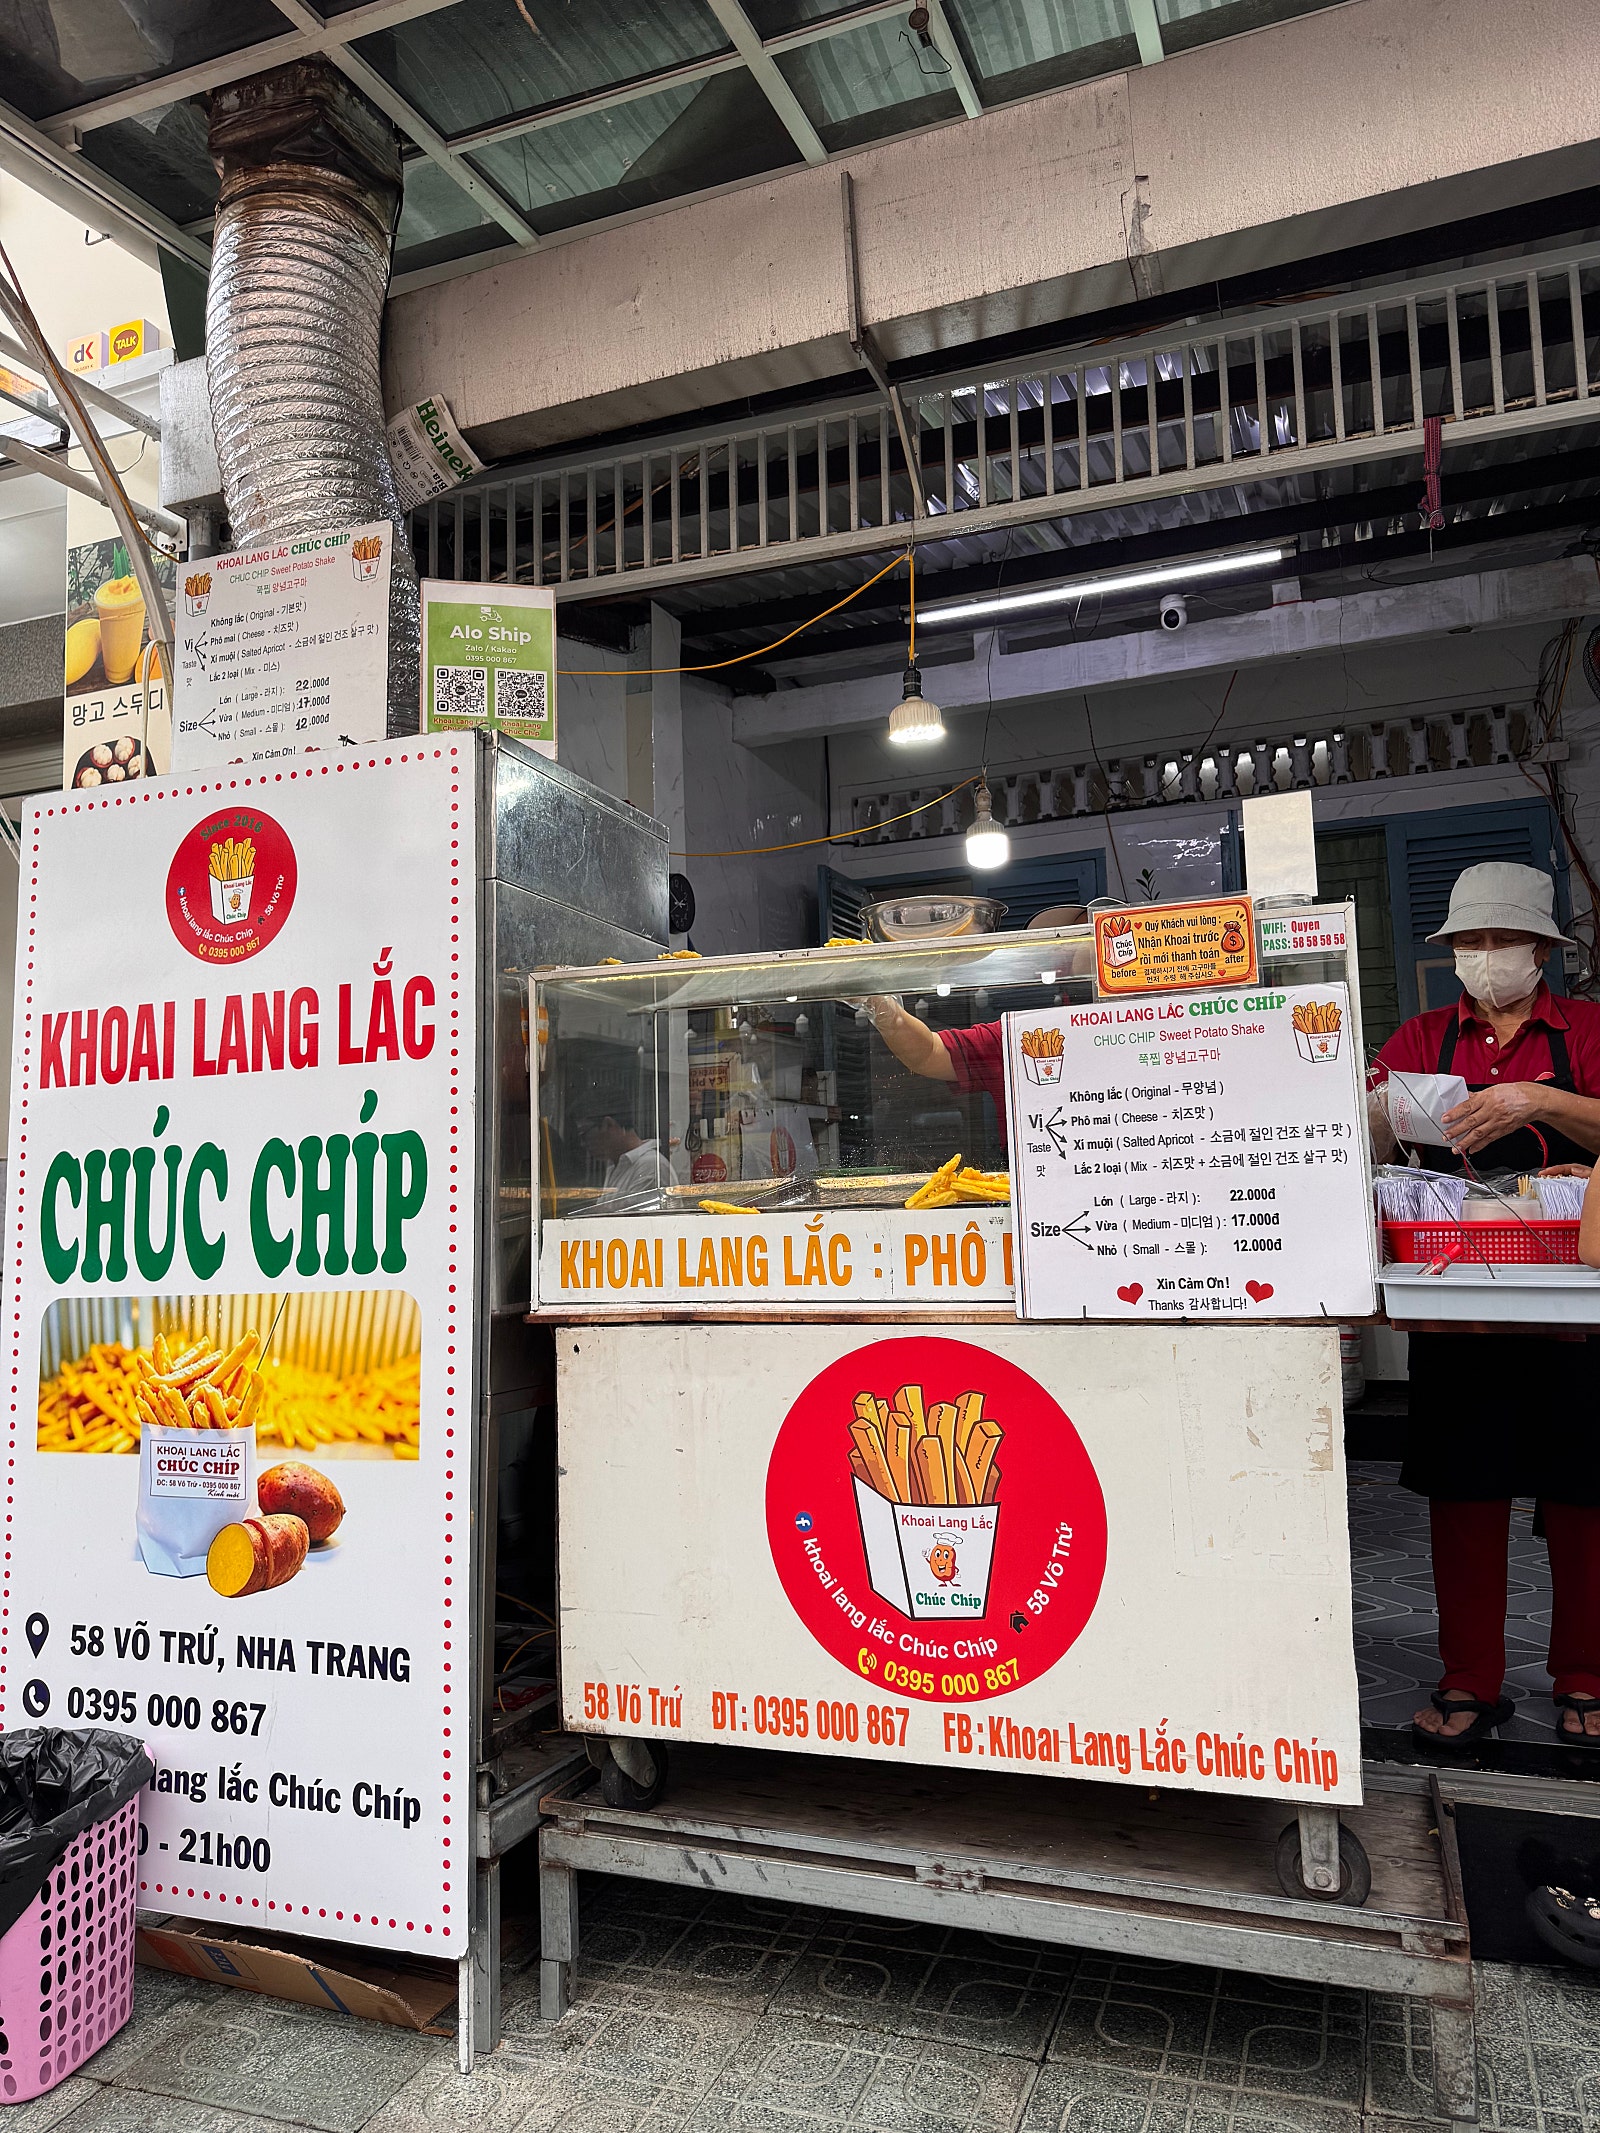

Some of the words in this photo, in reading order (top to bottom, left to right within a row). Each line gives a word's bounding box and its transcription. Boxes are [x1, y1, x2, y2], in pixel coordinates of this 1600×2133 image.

[116, 336, 136, 349] TALK
[217, 556, 243, 570] KHOAI
[246, 551, 269, 564] LANG
[291, 538, 321, 555] CHÚC
[324, 531, 350, 546] CHÍP
[230, 572, 250, 583] CHUC
[252, 568, 269, 580] CHIP
[271, 565, 291, 576] Sweet
[293, 560, 313, 572] Potato
[315, 556, 335, 566] Shake
[450, 625, 482, 640] Alo
[488, 626, 531, 645] Ship
[492, 645, 517, 654] Kakao
[503, 656, 517, 664] 867
[72, 700, 104, 726] 망고
[200, 819, 230, 840] Since
[234, 814, 263, 833] 2016
[1145, 921, 1159, 932] Quý
[1161, 918, 1184, 930] Khách
[1186, 916, 1198, 927] vui
[1263, 922, 1286, 934] WIFI:
[1291, 921, 1319, 933] Quyen
[1138, 936, 1162, 950] Nhận
[1164, 934, 1190, 947] Khoai
[1193, 931, 1219, 943] trước
[1264, 938, 1290, 951] PASS:
[1293, 937, 1304, 948] 58
[1307, 936, 1317, 947] 58
[1320, 934, 1331, 946] 58
[1334, 933, 1345, 945] 58
[1140, 953, 1151, 965] rồi
[1153, 954, 1169, 964] mới
[1171, 950, 1197, 962] thanh
[1200, 949, 1220, 959] toán
[1225, 954, 1244, 964] after
[1111, 968, 1137, 979] before
[39, 1001, 175, 1089] KHOAI
[192, 986, 320, 1077] LANG
[338, 947, 435, 1064] LẮC
[1071, 1010, 1112, 1027] KHOAI
[1117, 1007, 1154, 1023] LANG
[1189, 996, 1238, 1016] CHÚC
[1243, 992, 1286, 1011] CHÍP
[1094, 1033, 1125, 1046] CHUC
[1129, 1032, 1155, 1044] CHIP
[1159, 1029, 1191, 1041] Sweet
[1194, 1027, 1228, 1039] Potato
[1232, 1022, 1265, 1035] Shake
[1070, 1090, 1104, 1103] Không
[1108, 1086, 1122, 1099] lắc
[1132, 1085, 1171, 1099] Original
[1182, 1080, 1216, 1094] 무양념
[1029, 1114, 1043, 1132] Vị
[1071, 1115, 1090, 1126] Phô
[1093, 1114, 1110, 1124] mai
[1122, 1112, 1158, 1123] Cheese
[1172, 1106, 1205, 1120] 치즈맛
[1088, 1138, 1113, 1151] muội
[1123, 1136, 1155, 1148] Salted
[1158, 1134, 1194, 1147] Apricot
[1210, 1128, 1246, 1143] 소금에
[1249, 1127, 1273, 1141] 절인
[1276, 1126, 1301, 1139] 건조
[1304, 1124, 1328, 1138] 살구
[1027, 1142, 1051, 1153] Taste
[1037, 1165, 1046, 1177] 맛
[1075, 1162, 1092, 1174] Lắc
[1094, 1164, 1100, 1173] 2
[1104, 1162, 1121, 1175] loại
[1131, 1161, 1147, 1172] Mix
[1162, 1156, 1195, 1170] 치즈맛
[1209, 1154, 1244, 1168] 소금에
[1248, 1152, 1271, 1166] 절인
[1275, 1151, 1299, 1165] 건조
[1304, 1150, 1327, 1164] 살구
[40, 1104, 229, 1284] CHÚC
[250, 1089, 428, 1279] CHÍP
[1130, 1195, 1156, 1207] Large
[1167, 1191, 1188, 1203] 라지
[1230, 1188, 1275, 1201] 22.000đ
[1031, 1223, 1060, 1237] Size
[1096, 1220, 1117, 1231] Vừa
[1133, 1219, 1170, 1230] Medium
[1181, 1215, 1212, 1229] 미디엄
[1231, 1213, 1280, 1226] 17.000đ
[560, 1238, 664, 1290] KHOAI
[678, 1236, 769, 1288] LANG
[784, 1214, 852, 1286] LẮC
[905, 1221, 987, 1287] PHÔ
[1098, 1245, 1117, 1255] Nhỏ
[1133, 1244, 1159, 1254] Small
[1175, 1242, 1196, 1254] 스몰
[1233, 1239, 1282, 1252] 12.000đ
[1157, 1279, 1175, 1289] Xin
[1178, 1277, 1204, 1289] Cảm
[1148, 1300, 1184, 1310] Thanks
[1189, 1297, 1247, 1310] 감사합니다!
[157, 1446, 186, 1456] KHOAI
[190, 1448, 216, 1457] LANG
[157, 1457, 198, 1472] CHÚC
[203, 1459, 239, 1475] CHÍP
[901, 1515, 935, 1527] Khoai
[939, 1517, 968, 1531] Lang
[972, 1516, 993, 1530] Lắc
[916, 1593, 945, 1606] Chúc
[951, 1593, 982, 1609] Chíp
[70, 1624, 104, 1657] 58
[114, 1620, 150, 1661] VÕ
[160, 1624, 225, 1673] TRỨ,
[236, 1635, 296, 1672] NHA
[306, 1640, 411, 1683] TRANG
[884, 1661, 934, 1694] 0395
[942, 1673, 979, 1696] 000
[983, 1658, 1020, 1690] 867
[67, 1687, 137, 1724] 0395
[148, 1693, 201, 1730] 000
[211, 1700, 267, 1736] 867
[584, 1682, 609, 1720] 58
[616, 1684, 641, 1724] Võ
[648, 1685, 683, 1728] Trứ
[712, 1691, 748, 1731] ĐT:
[754, 1695, 809, 1738] 0395
[817, 1700, 858, 1742] 000
[867, 1705, 910, 1747] 867
[1068, 1722, 1131, 1775] Lang
[1139, 1718, 1186, 1773] Lắc
[1196, 1733, 1264, 1781] Chúc
[1274, 1737, 1338, 1791] Chíp
[218, 1762, 258, 1802] lắc
[269, 1772, 341, 1814] Chúc
[353, 1782, 421, 1829] Chíp
[179, 1828, 271, 1872] 21h00
